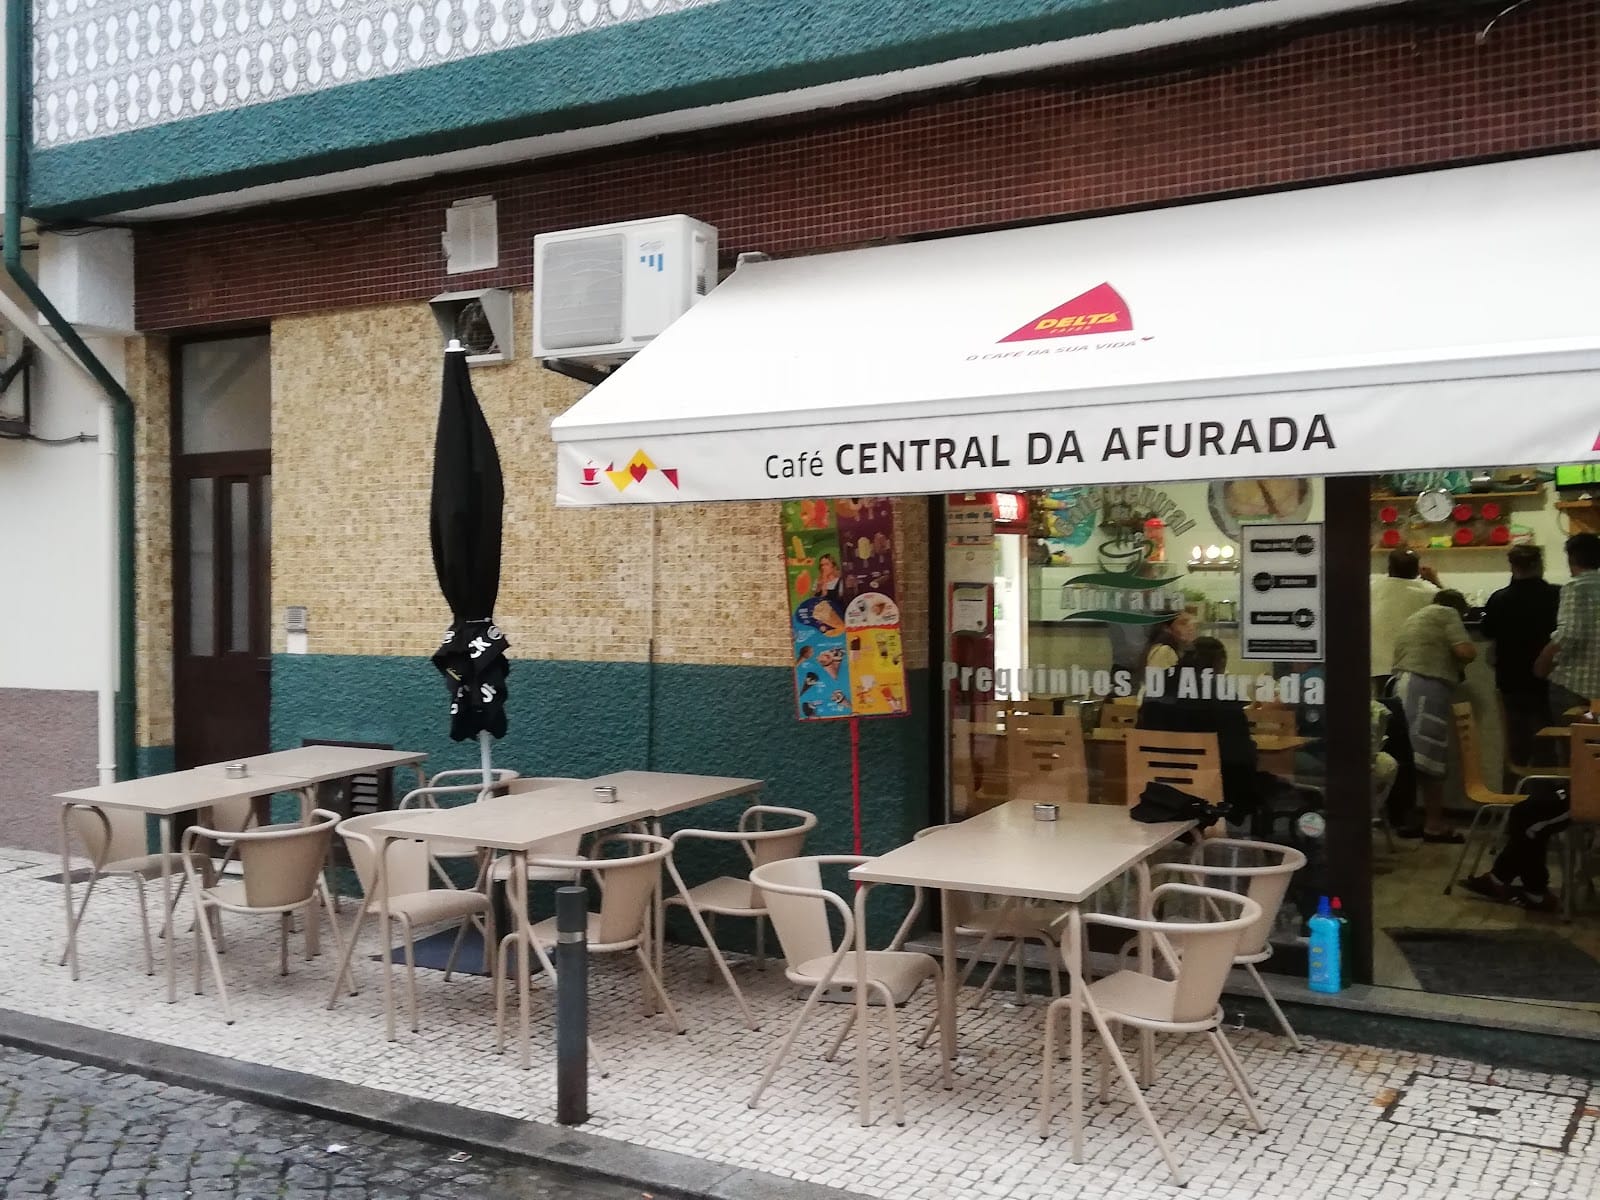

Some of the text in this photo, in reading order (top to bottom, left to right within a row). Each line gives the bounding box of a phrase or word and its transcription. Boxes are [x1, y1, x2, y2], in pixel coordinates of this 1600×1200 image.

[1034, 312, 1120, 331] DELTA
[1027, 348, 1050, 356] DA
[1054, 344, 1089, 353] SUA
[1095, 341, 1137, 350] VIDA
[766, 414, 1336, 479] Café CENTRAL DA AFURADA
[942, 661, 1133, 697] Preguinhos
